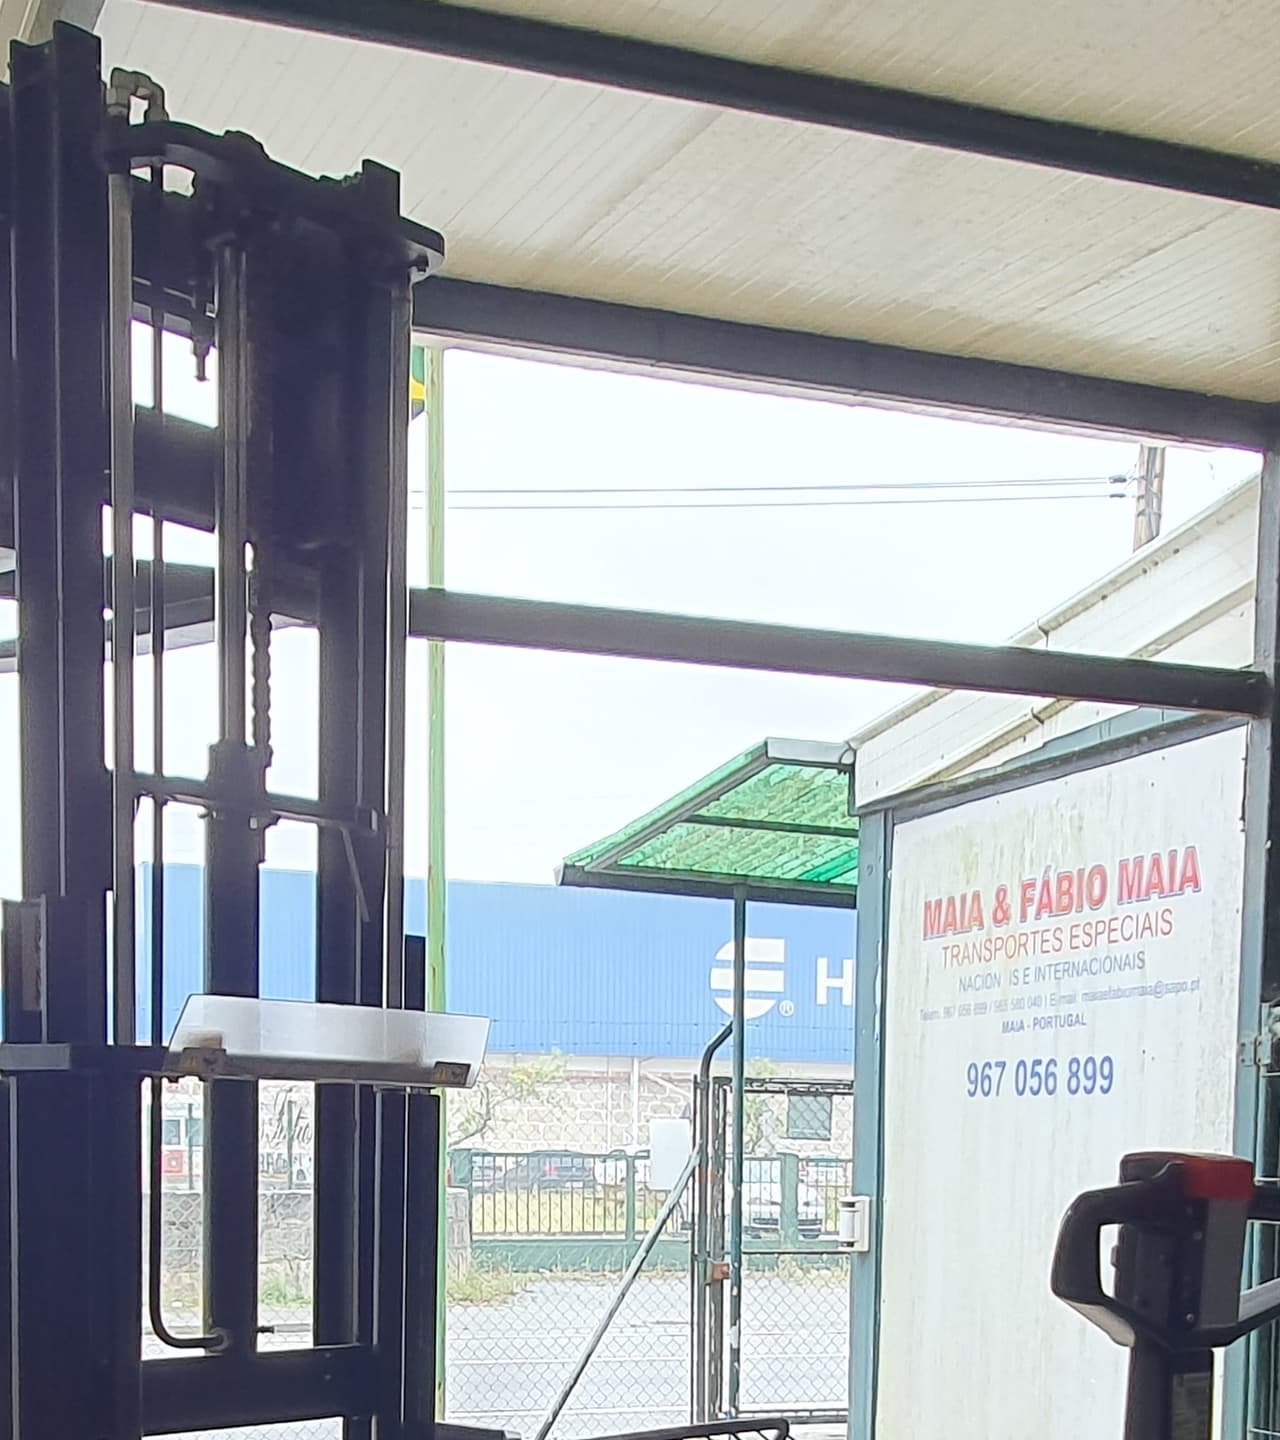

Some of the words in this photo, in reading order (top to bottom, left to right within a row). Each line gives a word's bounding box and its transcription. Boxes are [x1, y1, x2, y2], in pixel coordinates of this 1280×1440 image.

[923, 890, 984, 940] MAIA
[992, 884, 1011, 927] &
[1020, 865, 1108, 923] FÁBIO
[1117, 845, 1202, 906] MAIA
[942, 926, 1063, 969] TRANSPORTES
[1070, 908, 1173, 950] ESPECIAIS
[1023, 967, 1031, 985] E
[1034, 950, 1146, 981] INTERNACIONAIS
[1002, 1019, 1025, 1034] MAIA
[1033, 1012, 1087, 1031] PORTUGAL
[967, 1061, 1006, 1097] 967
[1015, 1058, 1057, 1096] 056
[1067, 1055, 1114, 1095] 899
